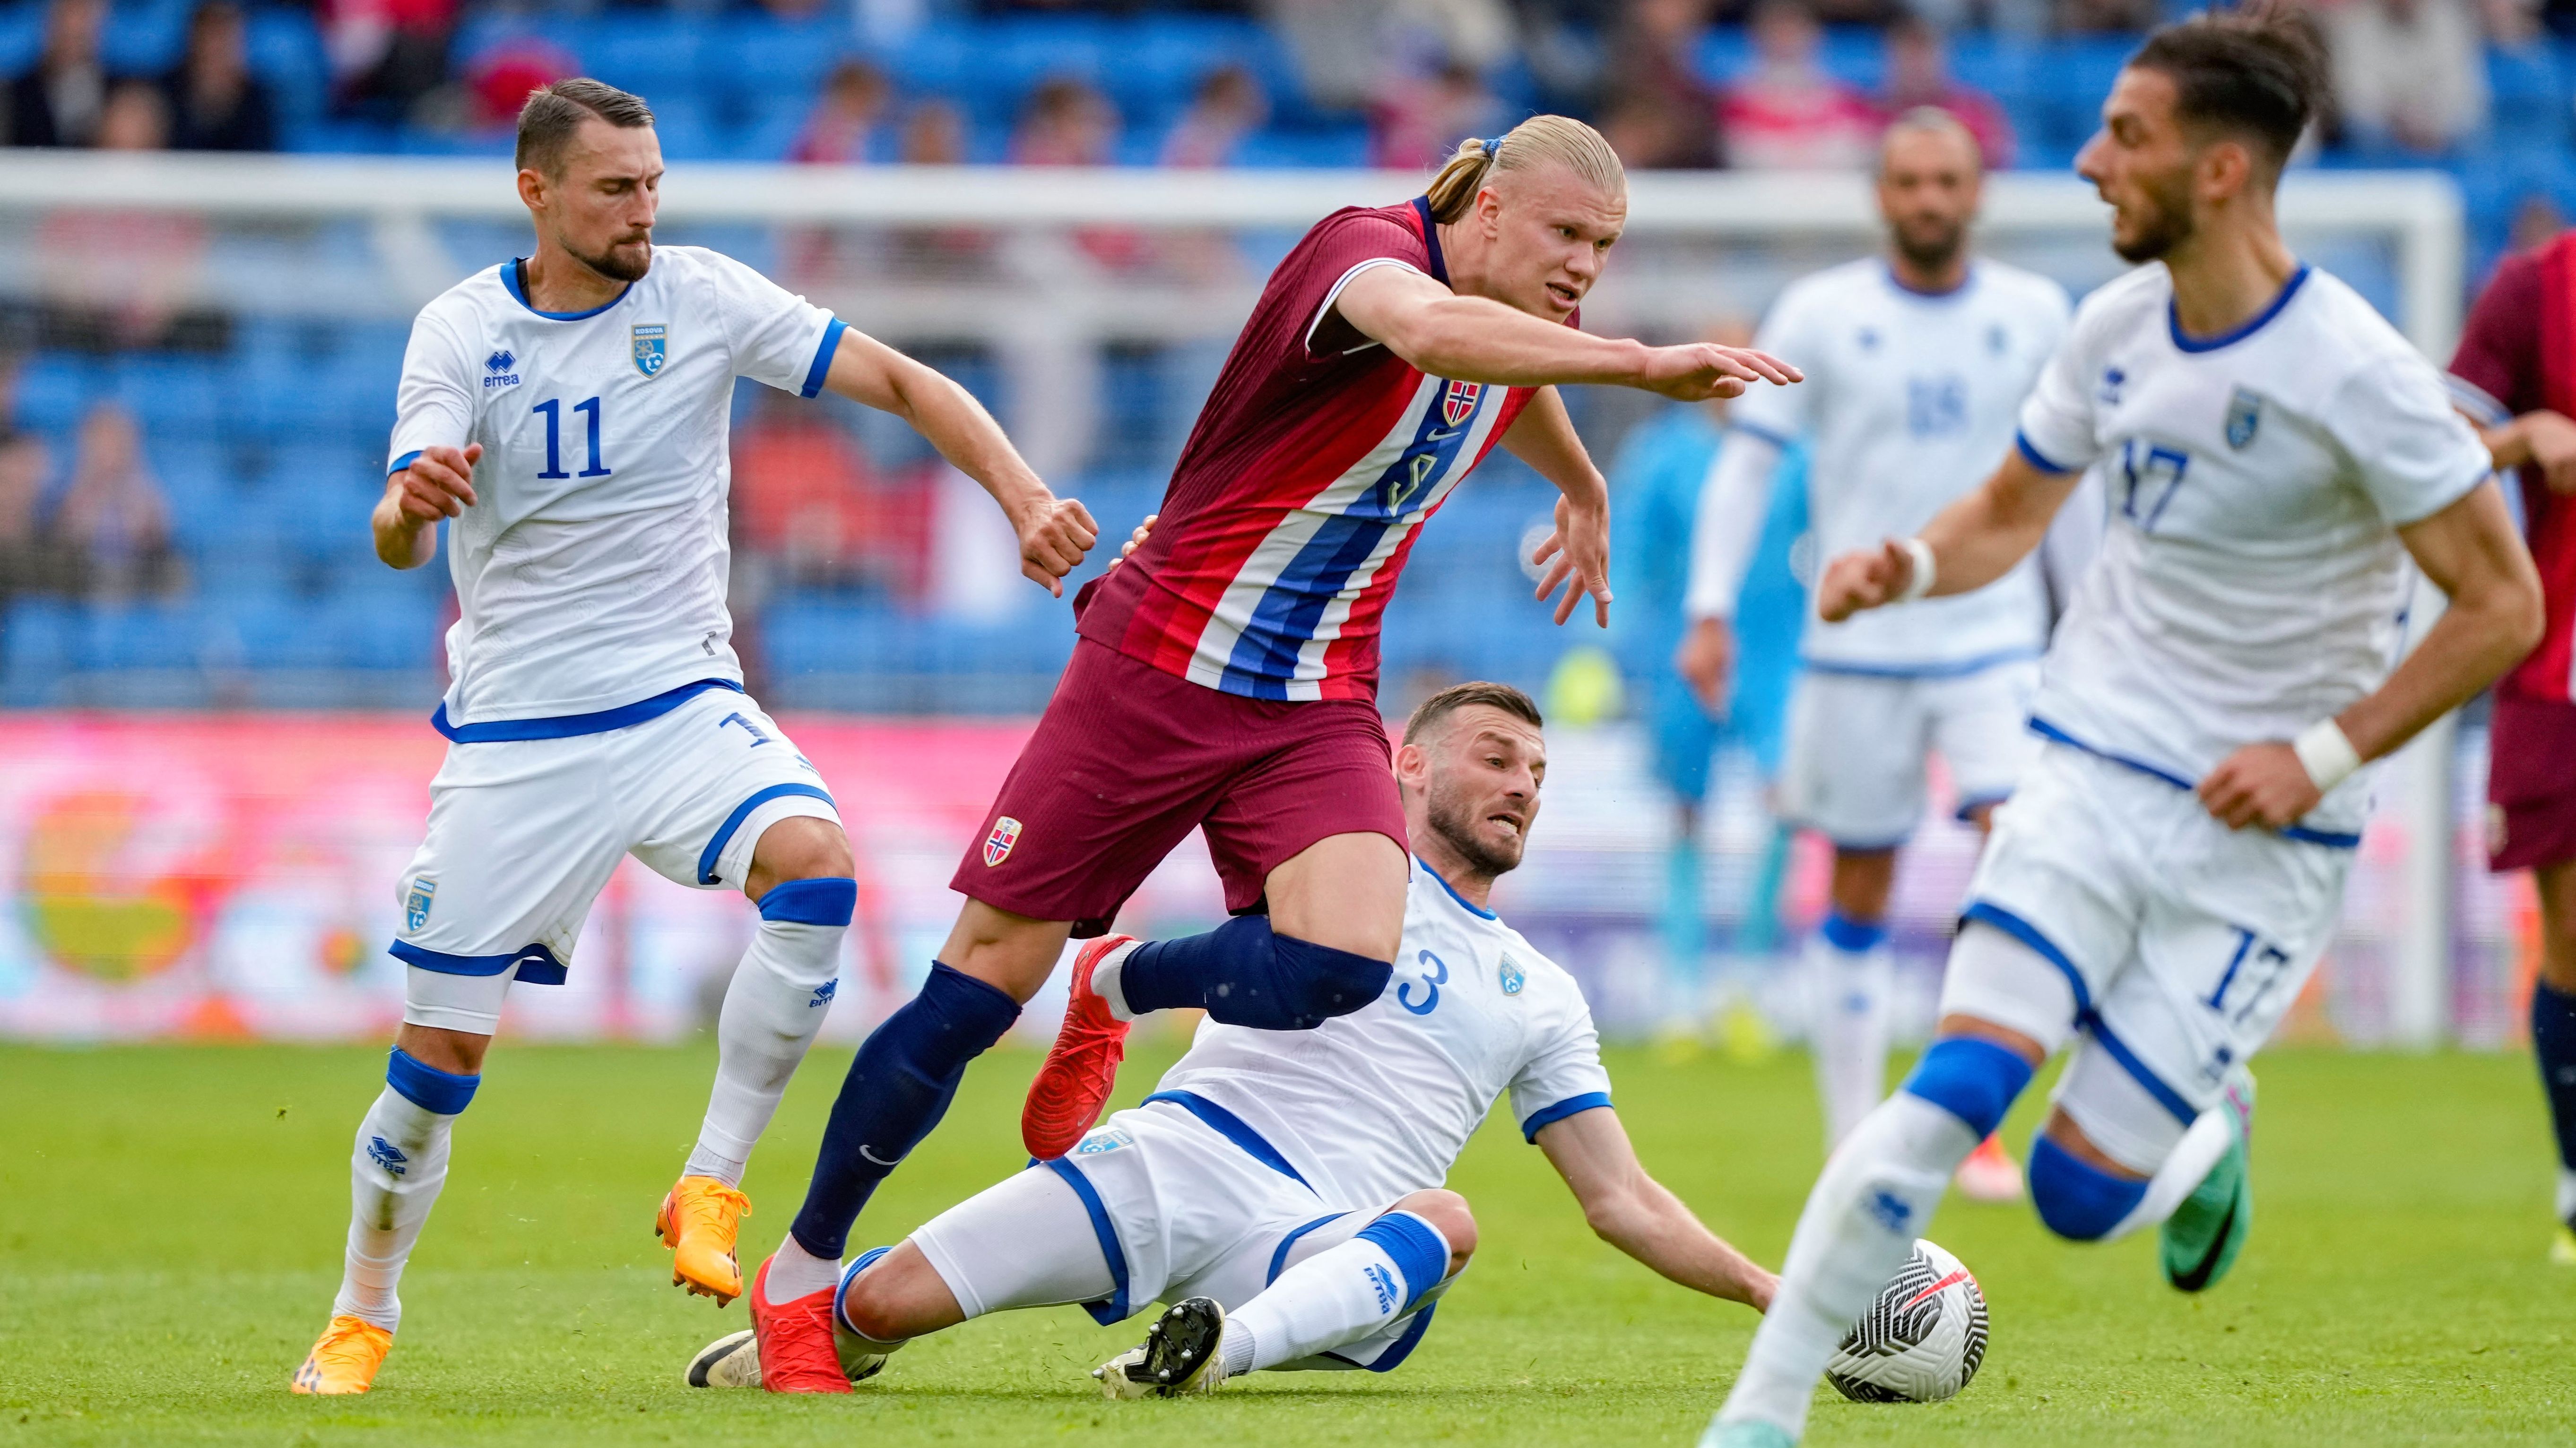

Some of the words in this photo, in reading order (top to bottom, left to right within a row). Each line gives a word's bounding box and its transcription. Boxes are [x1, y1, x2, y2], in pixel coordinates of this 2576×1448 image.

[634, 327, 664, 335] KOSOVA
[533, 396, 611, 479] 11
[2121, 438, 2189, 533] 17
[1397, 949, 1448, 1015] 3
[2196, 923, 2289, 1024] 17
